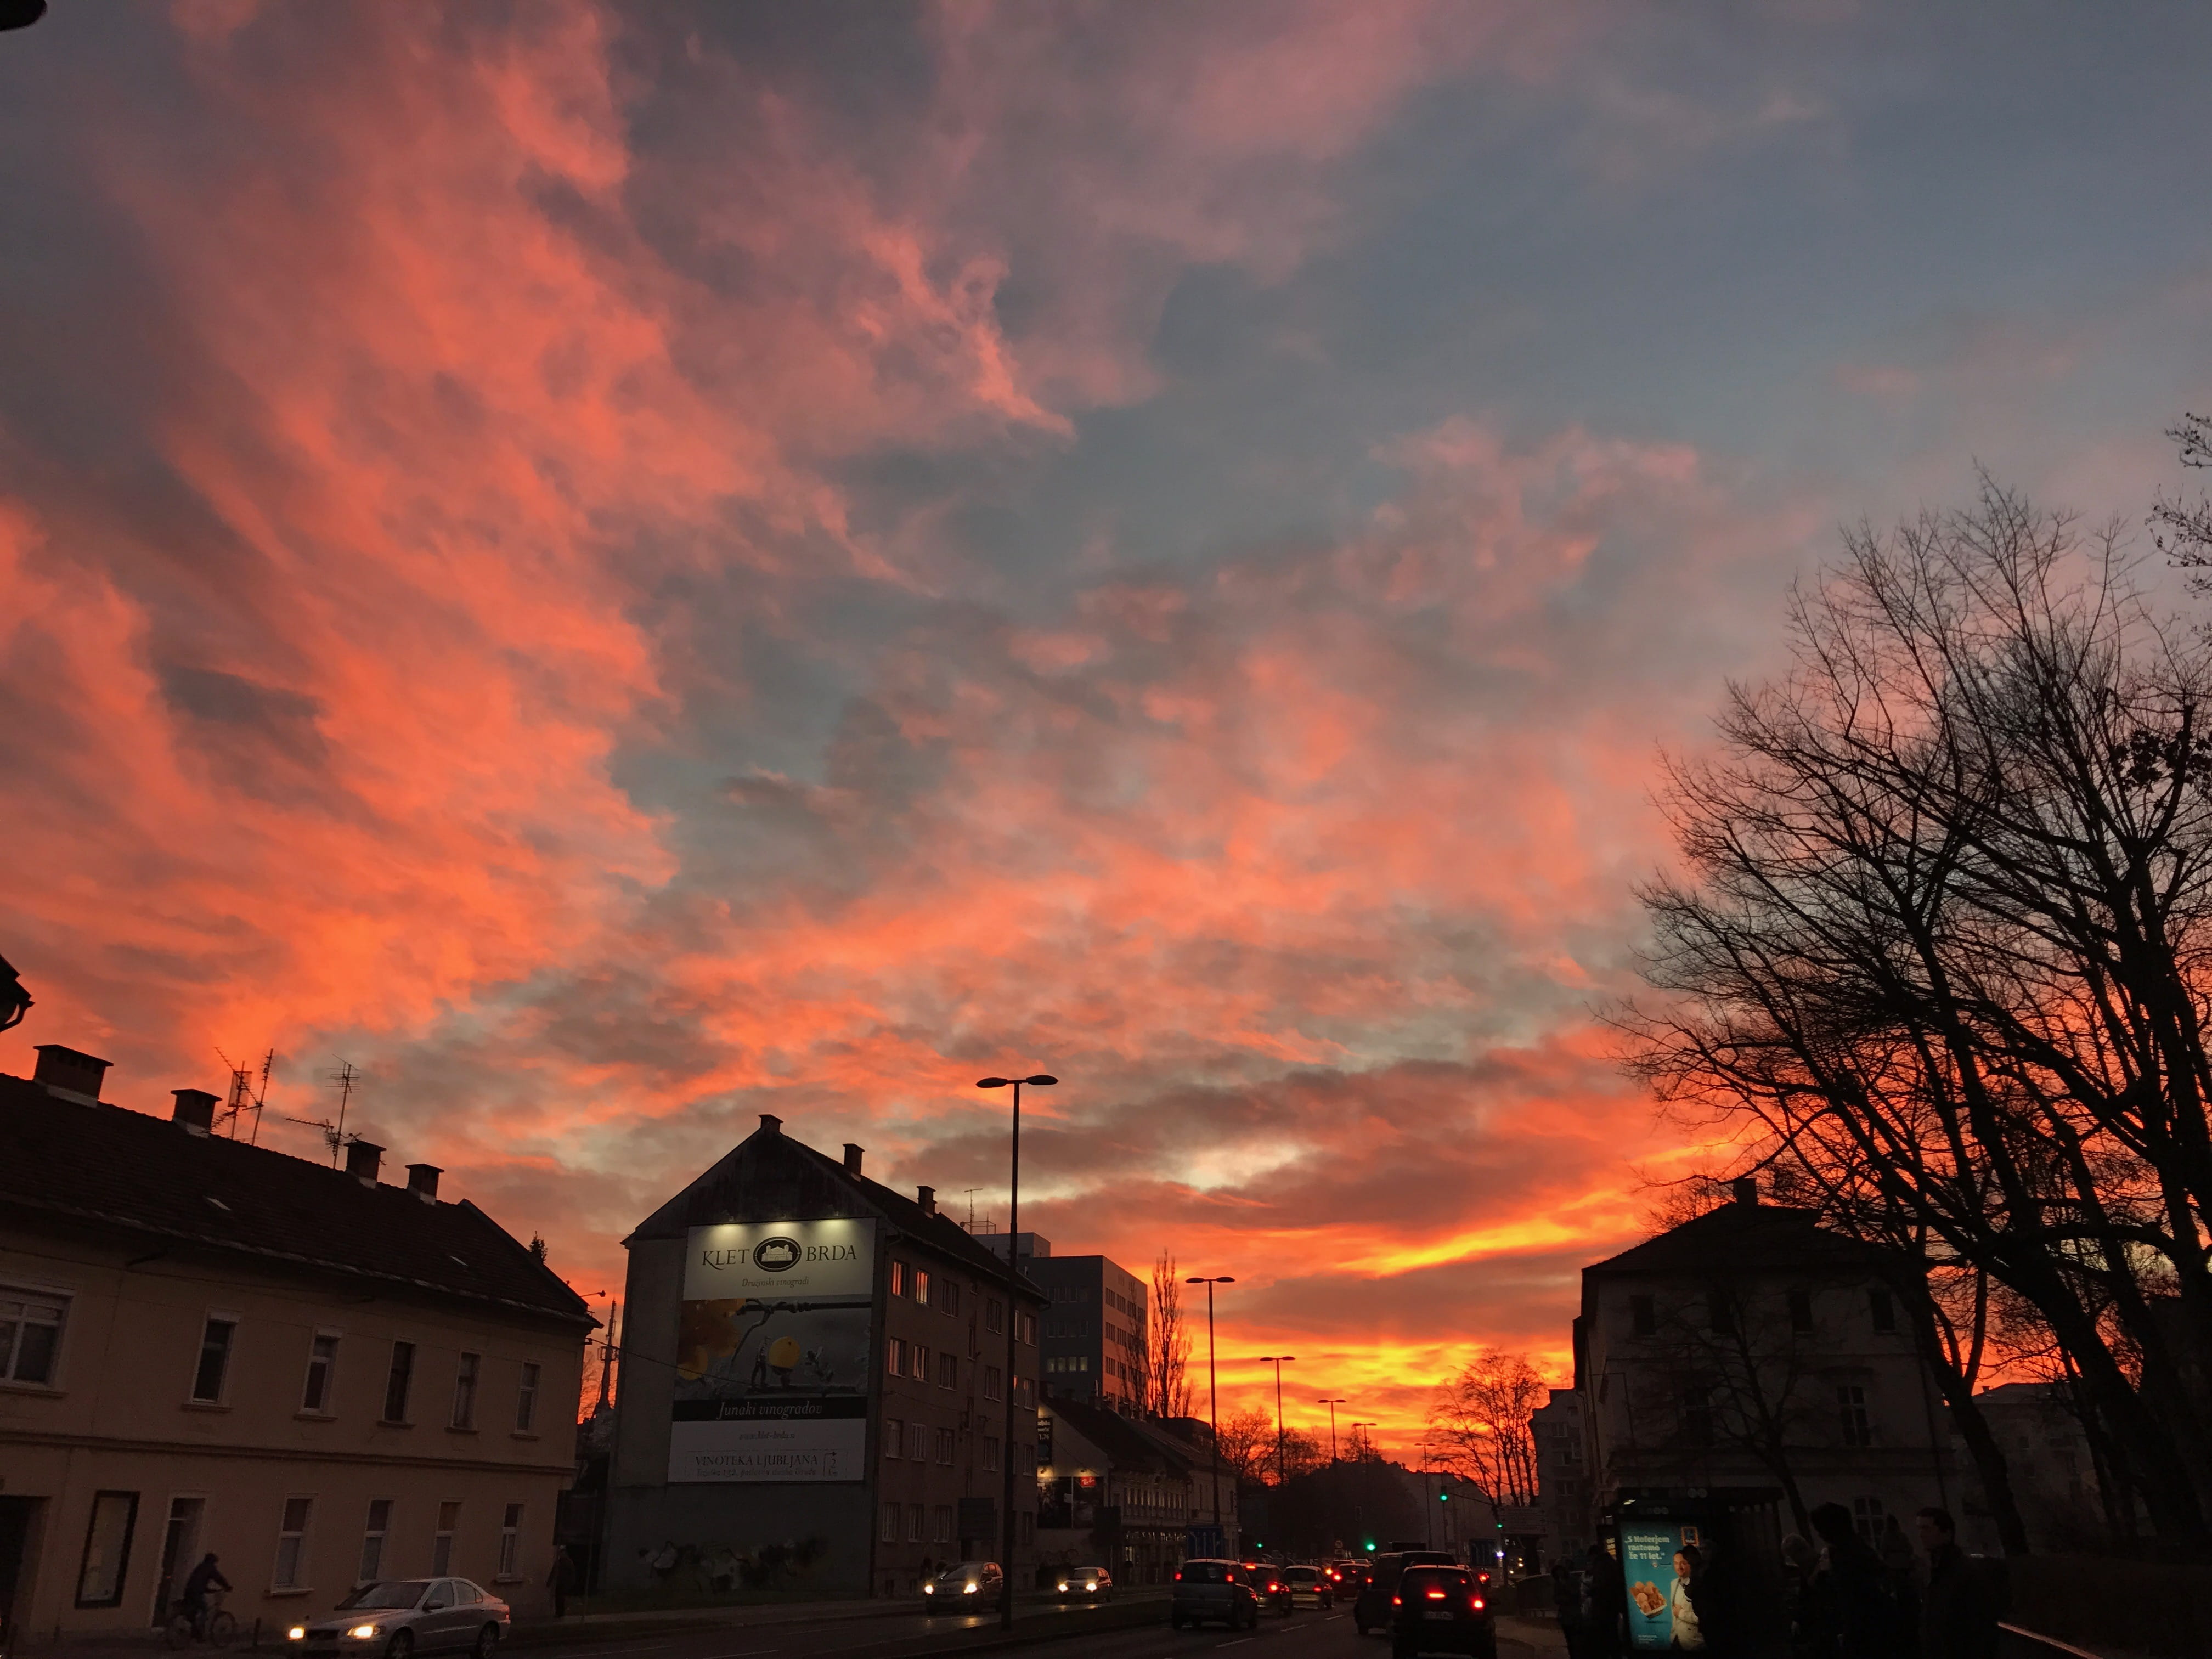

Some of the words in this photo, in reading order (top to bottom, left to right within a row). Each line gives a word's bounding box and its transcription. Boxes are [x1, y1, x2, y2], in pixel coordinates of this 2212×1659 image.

[702, 1249, 750, 1271] KLET
[806, 1245, 857, 1262] BRDA
[776, 1276, 809, 1289] vinogradi
[716, 1401, 756, 1420] Junaki
[759, 1400, 822, 1420] vinogradov
[696, 1455, 753, 1466] VINOTEKA
[757, 1455, 817, 1468] LJUBLJANA
